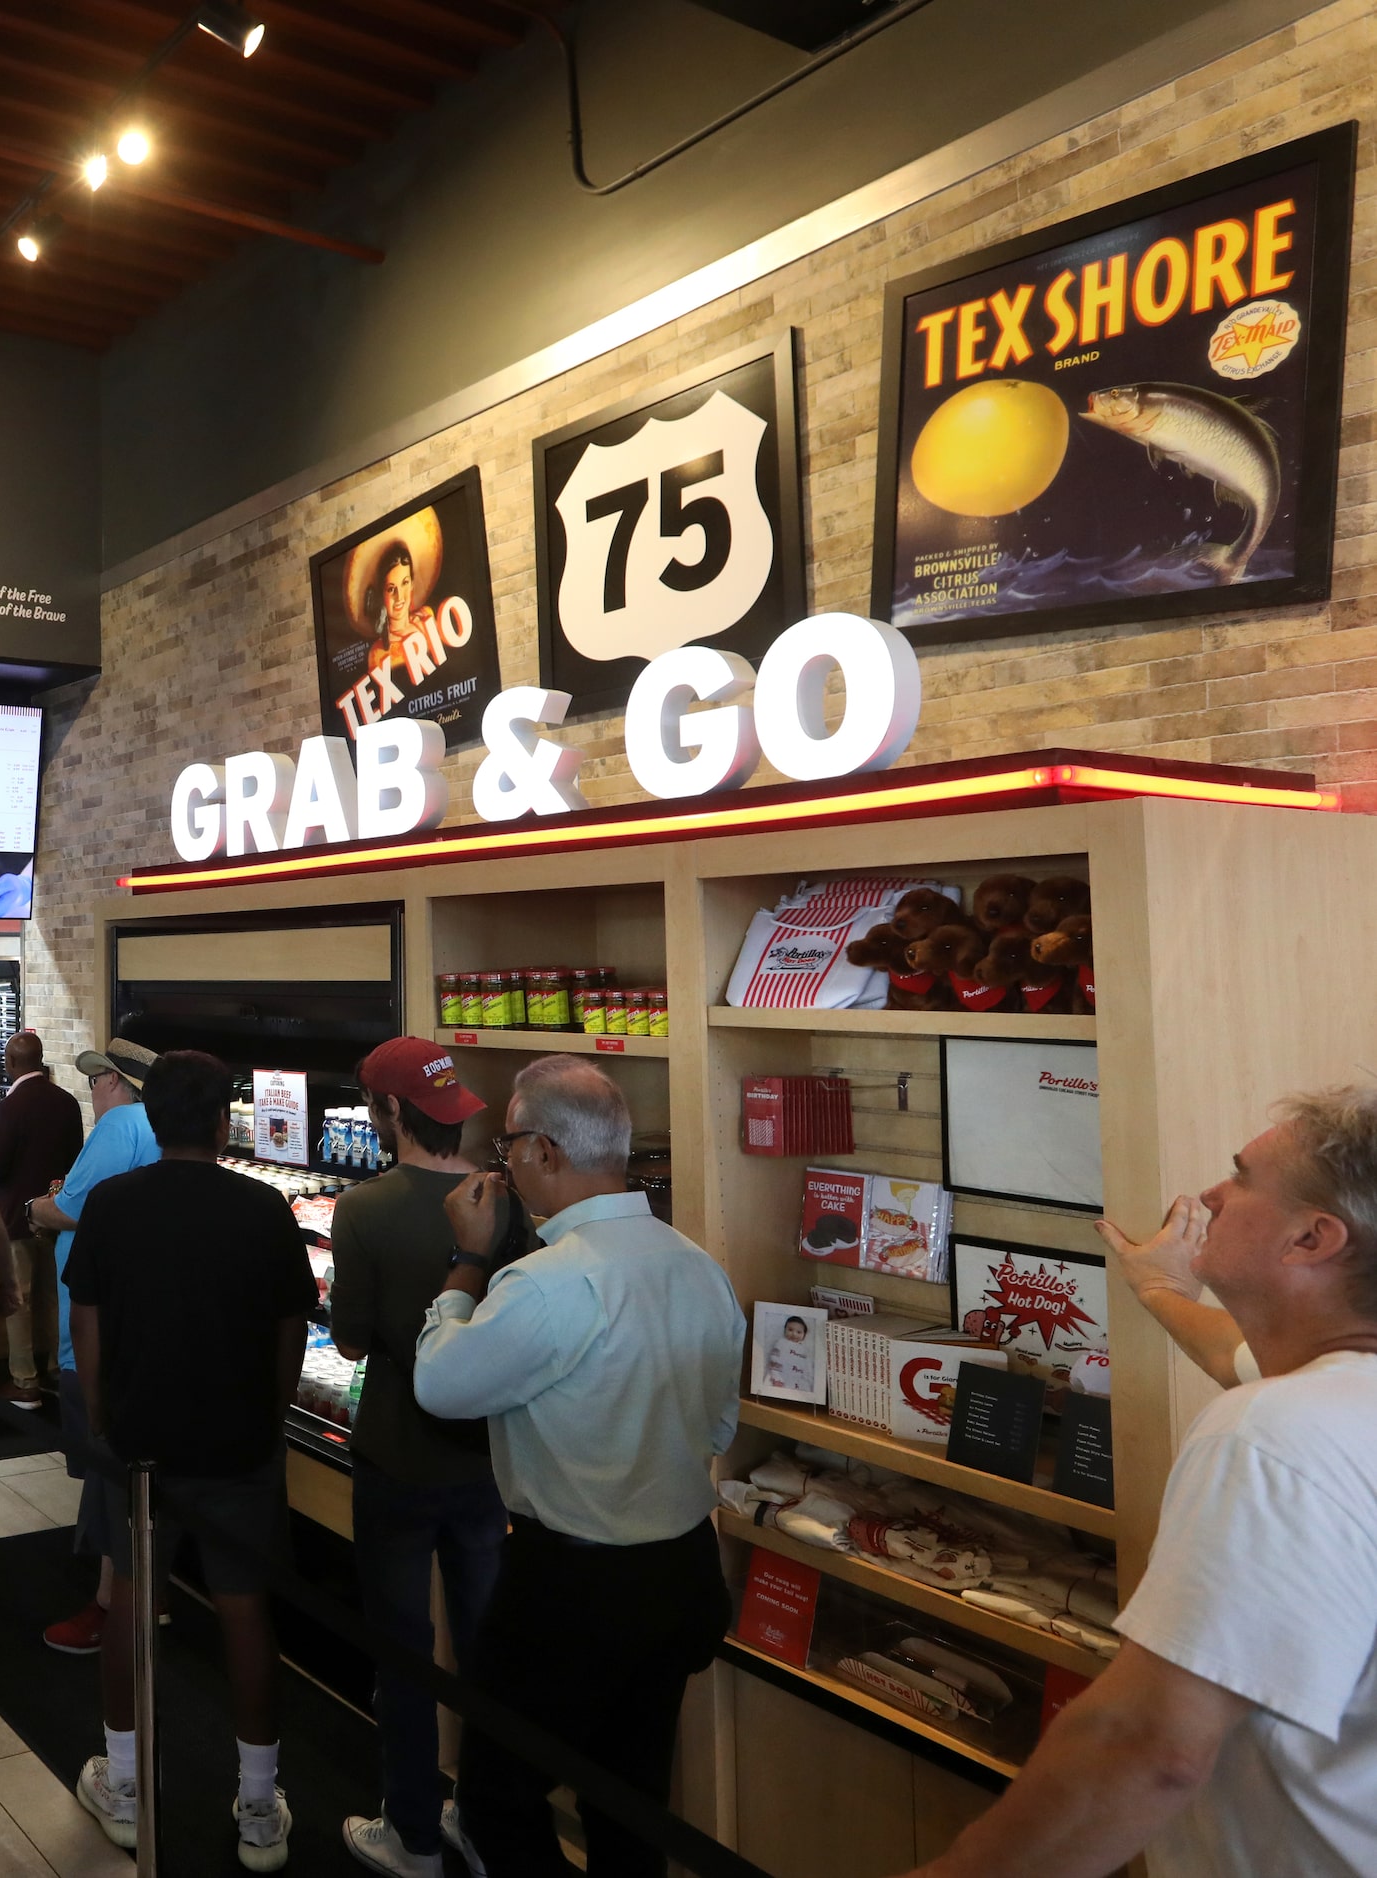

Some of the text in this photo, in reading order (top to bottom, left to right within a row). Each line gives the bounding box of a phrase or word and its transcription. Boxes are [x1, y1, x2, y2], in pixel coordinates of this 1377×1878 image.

[915, 198, 1297, 389] TEX SHORE
[1224, 318, 1236, 330] RIO
[1054, 351, 1100, 371] BRAND
[1222, 350, 1282, 375] CITRUS EXCHANGE
[585, 449, 732, 614] 75
[915, 551, 944, 562] PACKED
[954, 544, 986, 556] SHIPPED
[914, 552, 998, 578] BROWNSVILLE
[934, 570, 979, 590] CITRUS
[6, 588, 26, 602] the
[28, 590, 52, 605] Free
[915, 582, 998, 605] ASSOCIATION
[970, 598, 997, 607] TEXAS
[0, 603, 12, 616] of
[13, 604, 32, 619] the
[34, 606, 66, 622] Brave
[336, 595, 472, 740] TEX RIO
[408, 690, 444, 714] CITRUS
[447, 677, 478, 700] FRUIT
[170, 611, 923, 862] GRAB & GO
[1039, 1071, 1098, 1092] Portillo's
[264, 1088, 292, 1099] ITALIAN BEEF
[746, 1092, 779, 1100] BIRTHDAY
[259, 1098, 269, 1107] TAKE
[272, 1099, 284, 1108] MAKE
[285, 1100, 299, 1110] GUIDE
[808, 1180, 860, 1197] EVERYTHING
[821, 1200, 846, 1212] CAKE
[877, 1212, 908, 1226] HAPPY
[996, 1263, 1079, 1297] Portillo's
[1008, 1291, 1067, 1316] Hot Dog!
[753, 1576, 768, 1586] make
[770, 1583, 782, 1592] your
[784, 1588, 794, 1596] tail
[764, 1571, 802, 1591] Our swag will
[756, 1592, 799, 1615] COMING SOON
[866, 1670, 912, 1700] HOT DOG
